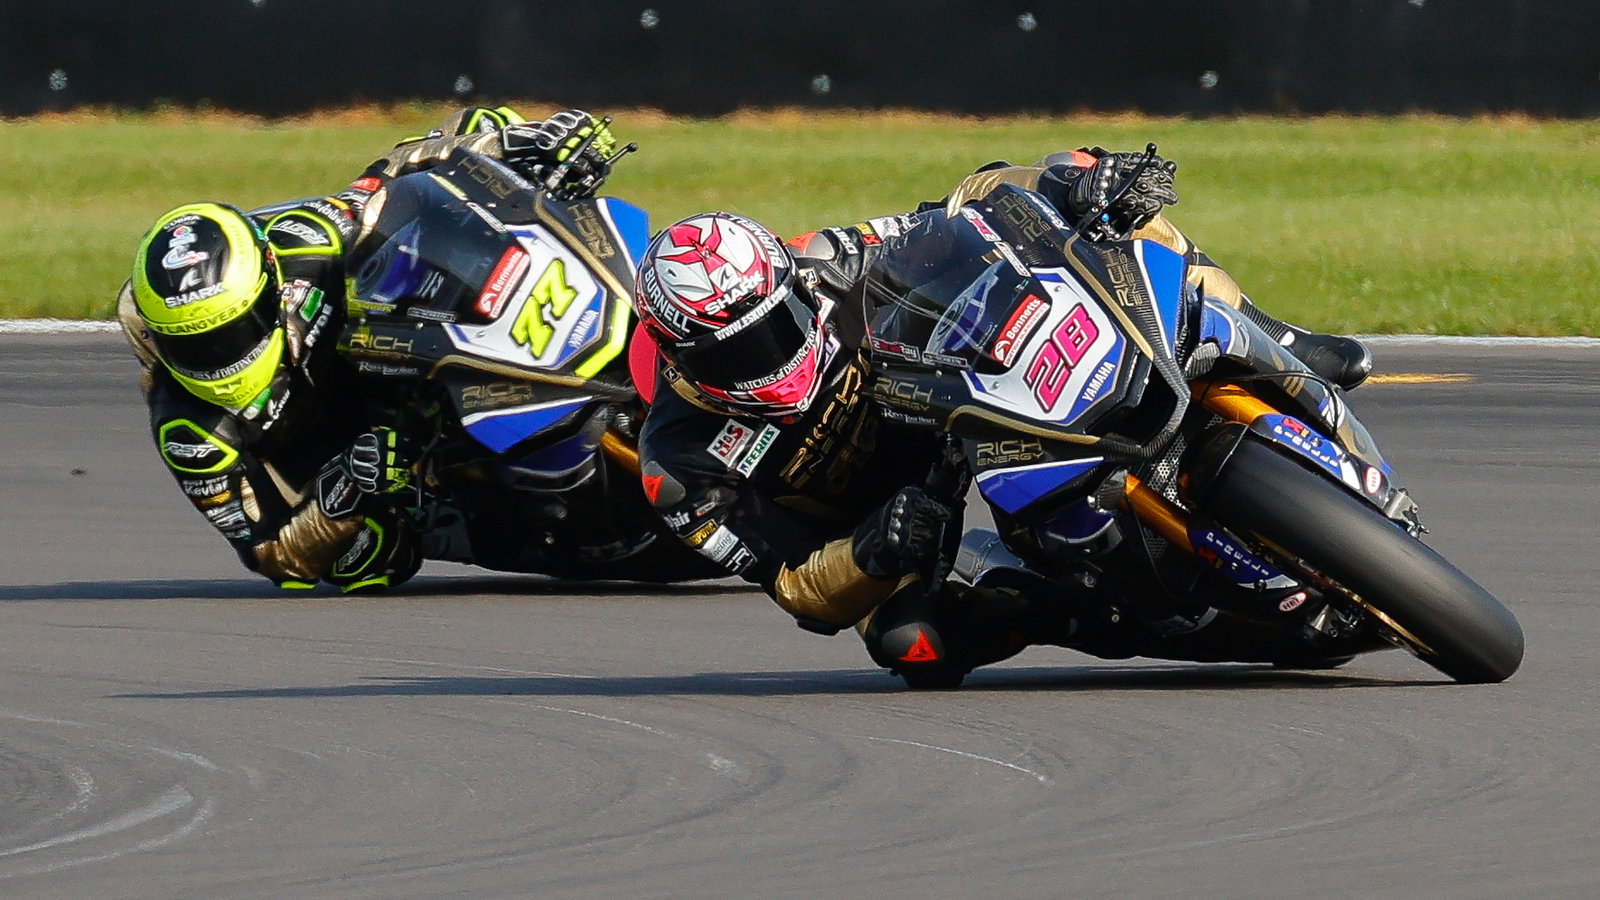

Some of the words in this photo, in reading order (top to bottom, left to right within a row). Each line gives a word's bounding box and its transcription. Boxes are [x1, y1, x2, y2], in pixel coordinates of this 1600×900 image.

[165, 282, 225, 308] SHARK
[704, 270, 765, 316] SHARK
[1101, 248, 1135, 307] RICH
[644, 266, 691, 333] BURNELL
[1005, 298, 1041, 340] Bennetts
[303, 303, 334, 348] RYDE
[350, 333, 414, 353] RICH
[675, 340, 696, 348] SHARK
[735, 373, 777, 390] WATCHES
[776, 368, 785, 380] of
[783, 327, 817, 376] DISTINCTION
[1022, 301, 1100, 414] 28
[874, 376, 934, 404] RICH
[1081, 361, 1116, 402] YAMAHA
[976, 439, 1042, 458] RICH
[976, 451, 1045, 466] ENERGY
[1274, 425, 1339, 468] PIRELLI
[184, 480, 229, 497] Kevlar
[1206, 531, 1270, 577] PIRELLI
